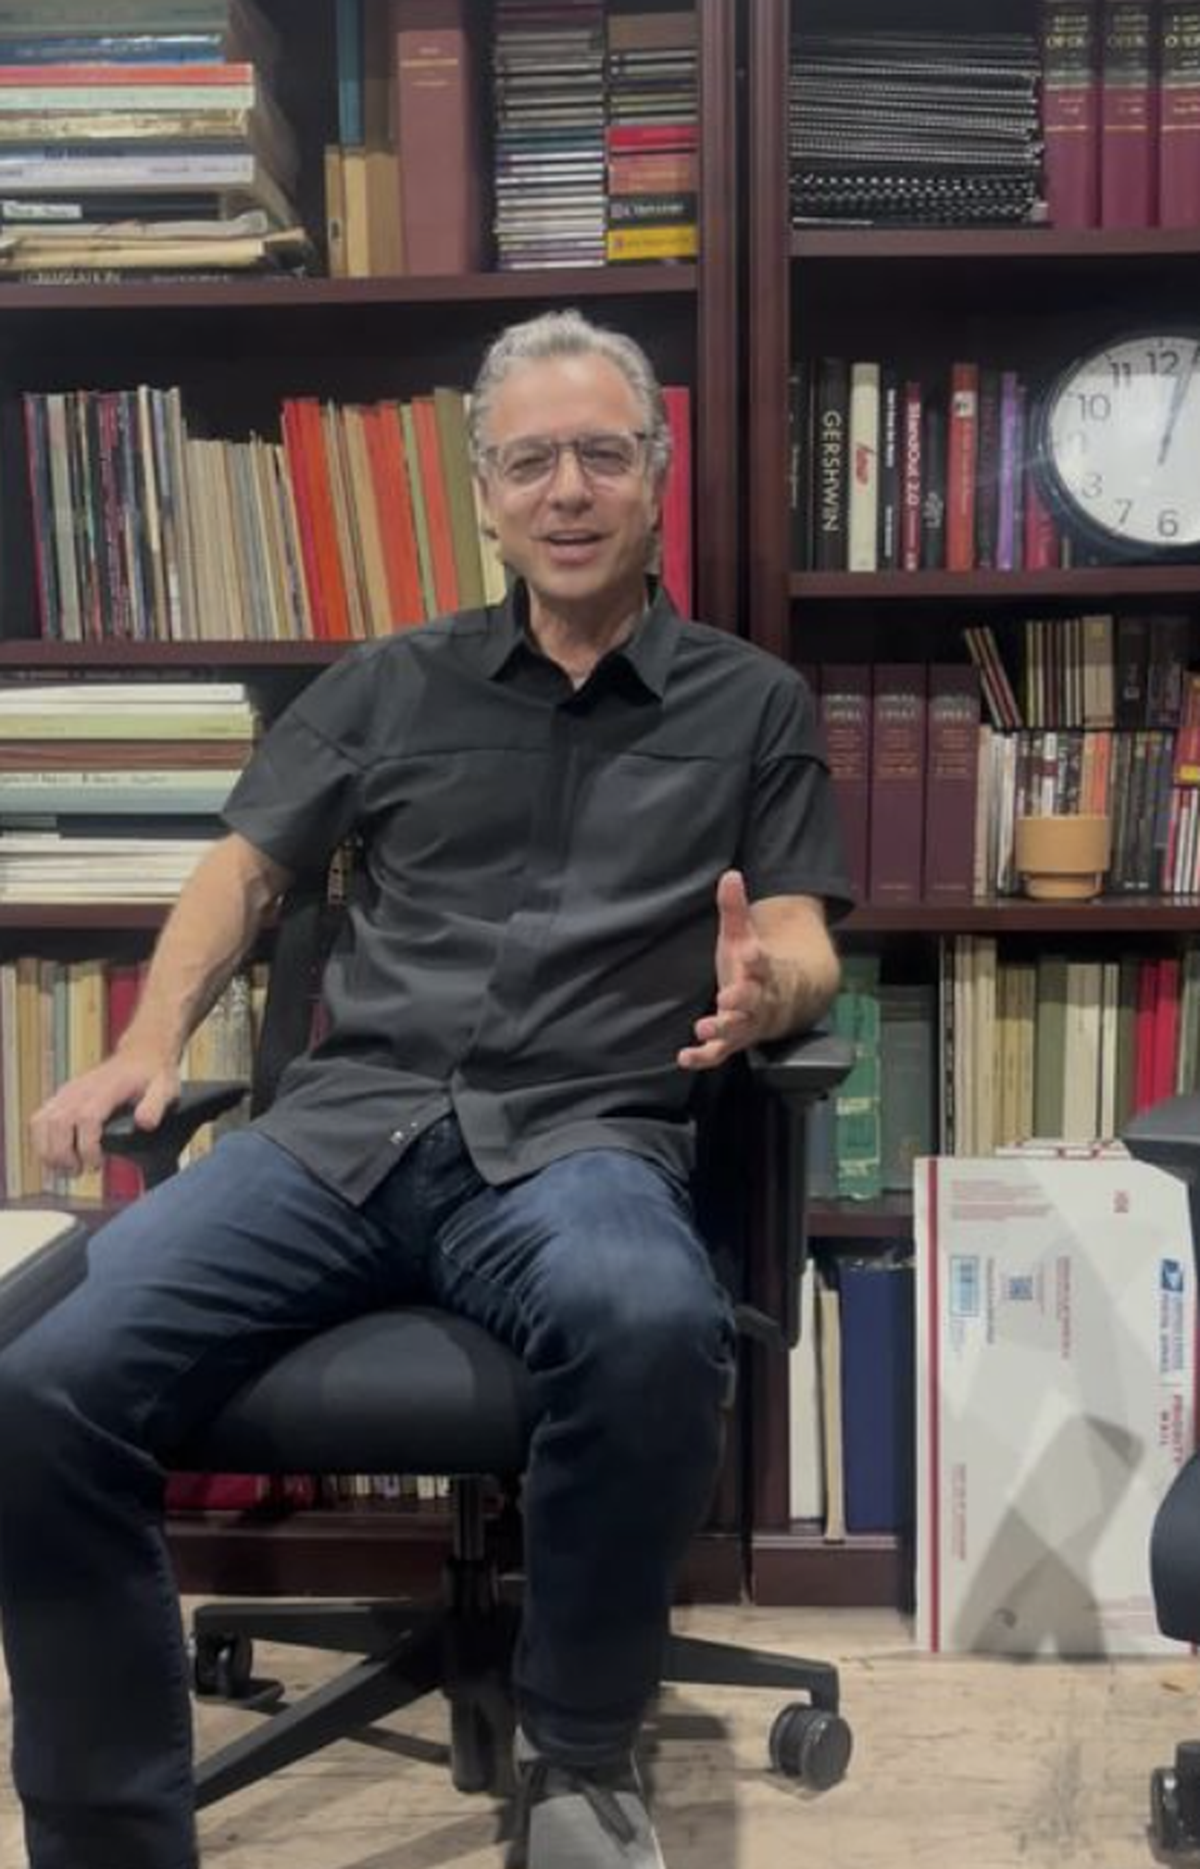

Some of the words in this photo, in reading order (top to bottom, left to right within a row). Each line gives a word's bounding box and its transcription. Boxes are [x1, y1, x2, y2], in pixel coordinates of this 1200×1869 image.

[1111, 362, 1132, 388] 11
[1147, 351, 1180, 377] 12
[1078, 393, 1112, 421] 10
[822, 411, 843, 532] GERSHWIN
[1115, 499, 1133, 525] 7
[1157, 509, 1179, 538] 6
